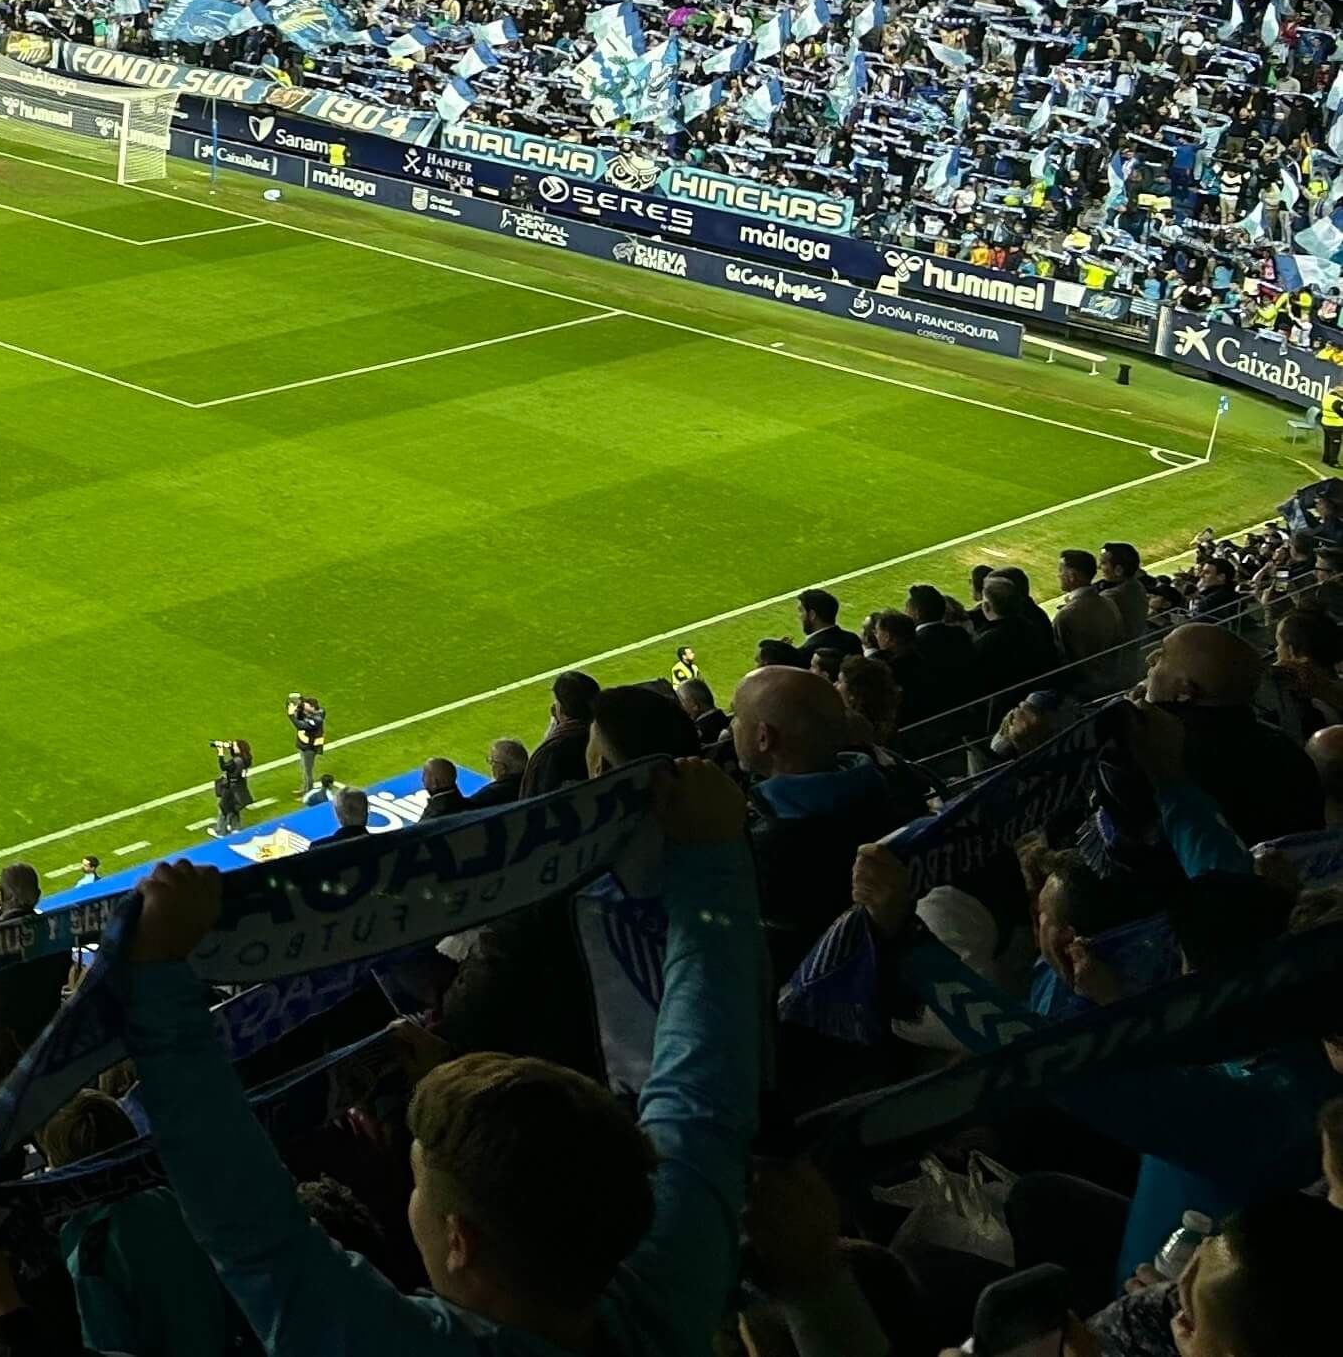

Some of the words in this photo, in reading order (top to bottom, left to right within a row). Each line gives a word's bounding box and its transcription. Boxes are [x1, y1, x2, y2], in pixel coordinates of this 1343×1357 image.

[72, 46, 180, 89] FONDO
[181, 69, 252, 101] SUR
[19, 100, 73, 129] hummel
[318, 96, 409, 138] 1904
[216, 147, 271, 172] CaixaBank
[275, 129, 329, 156] Sanam
[446, 127, 595, 176] MALAKA
[422, 166, 433, 178] &
[435, 169, 474, 188] NEER
[426, 152, 472, 173] HARPER
[572, 186, 694, 227] SERES
[671, 170, 844, 228] HINCHAS
[516, 219, 569, 238] DENTAL
[634, 243, 687, 268] CUEVA
[922, 254, 1045, 312] hummel
[877, 302, 912, 323] DOÑA
[915, 312, 999, 342] FRANCISQUITA
